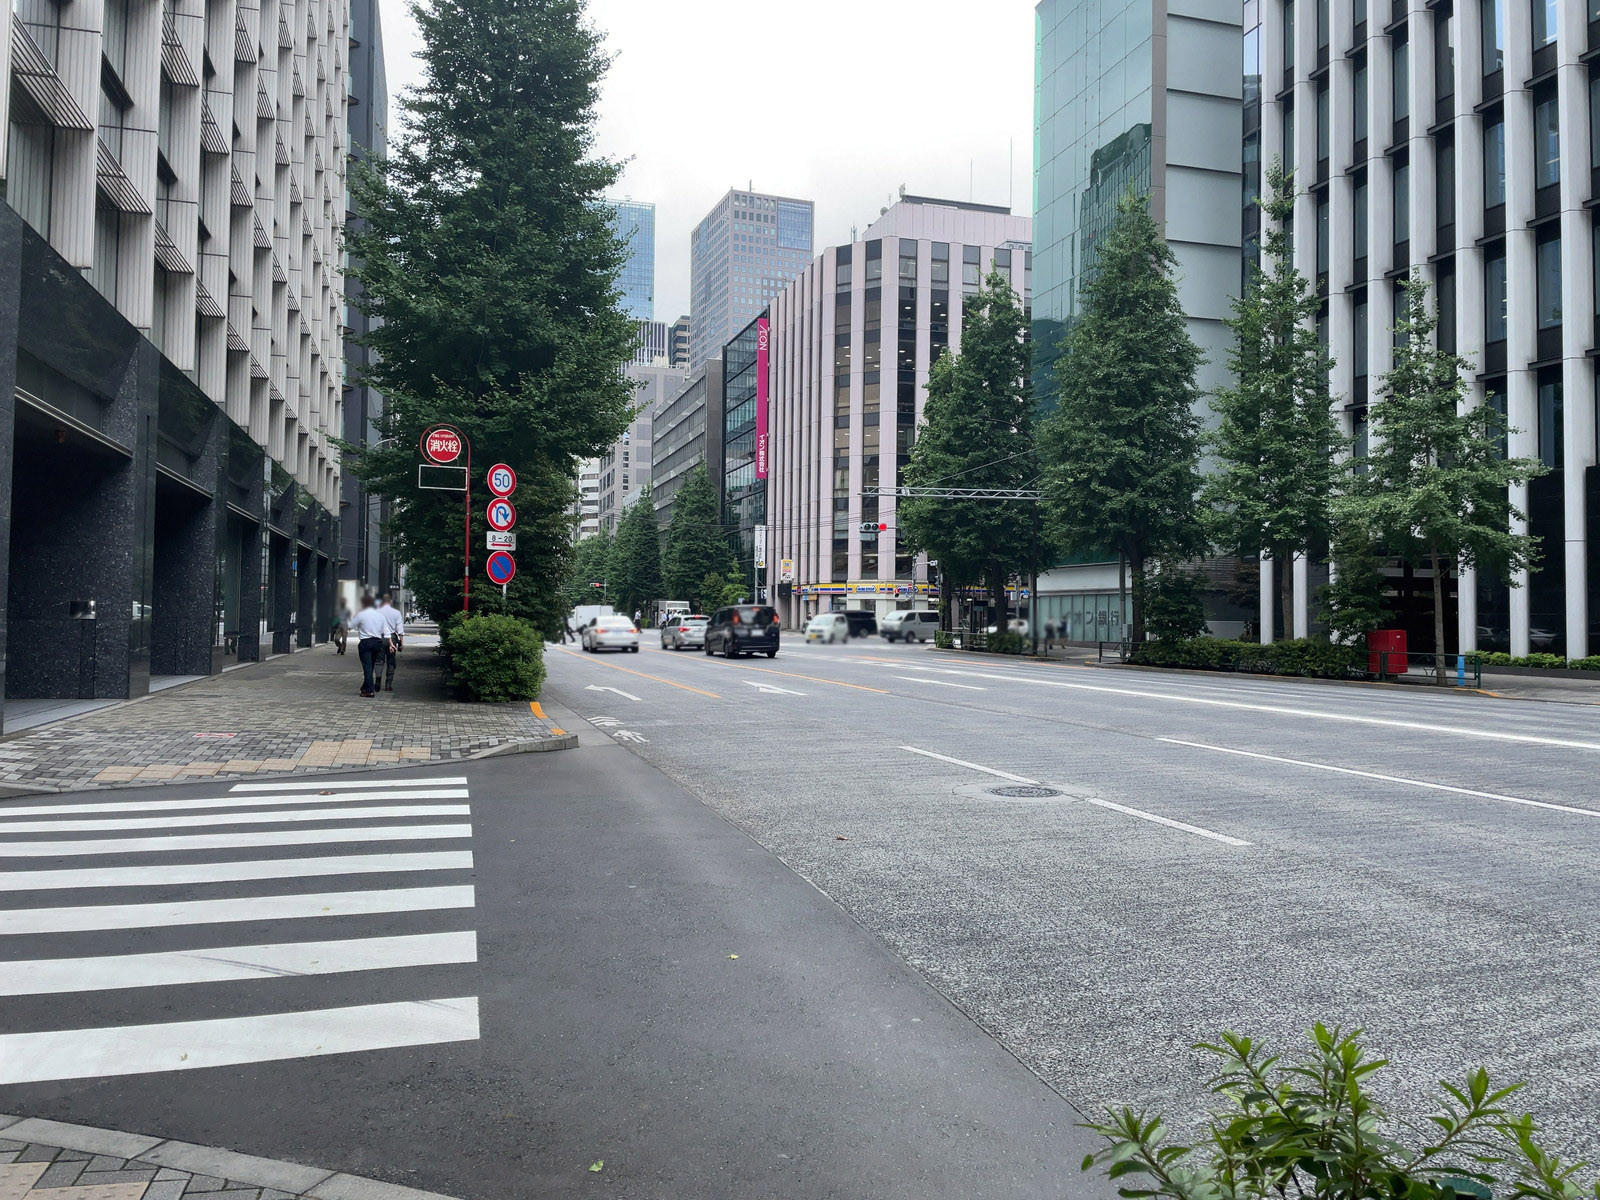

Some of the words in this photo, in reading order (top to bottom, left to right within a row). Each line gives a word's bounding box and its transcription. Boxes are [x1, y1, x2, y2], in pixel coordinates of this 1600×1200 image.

[430, 439, 458, 453] 消火栓
[494, 473, 510, 488] 50
